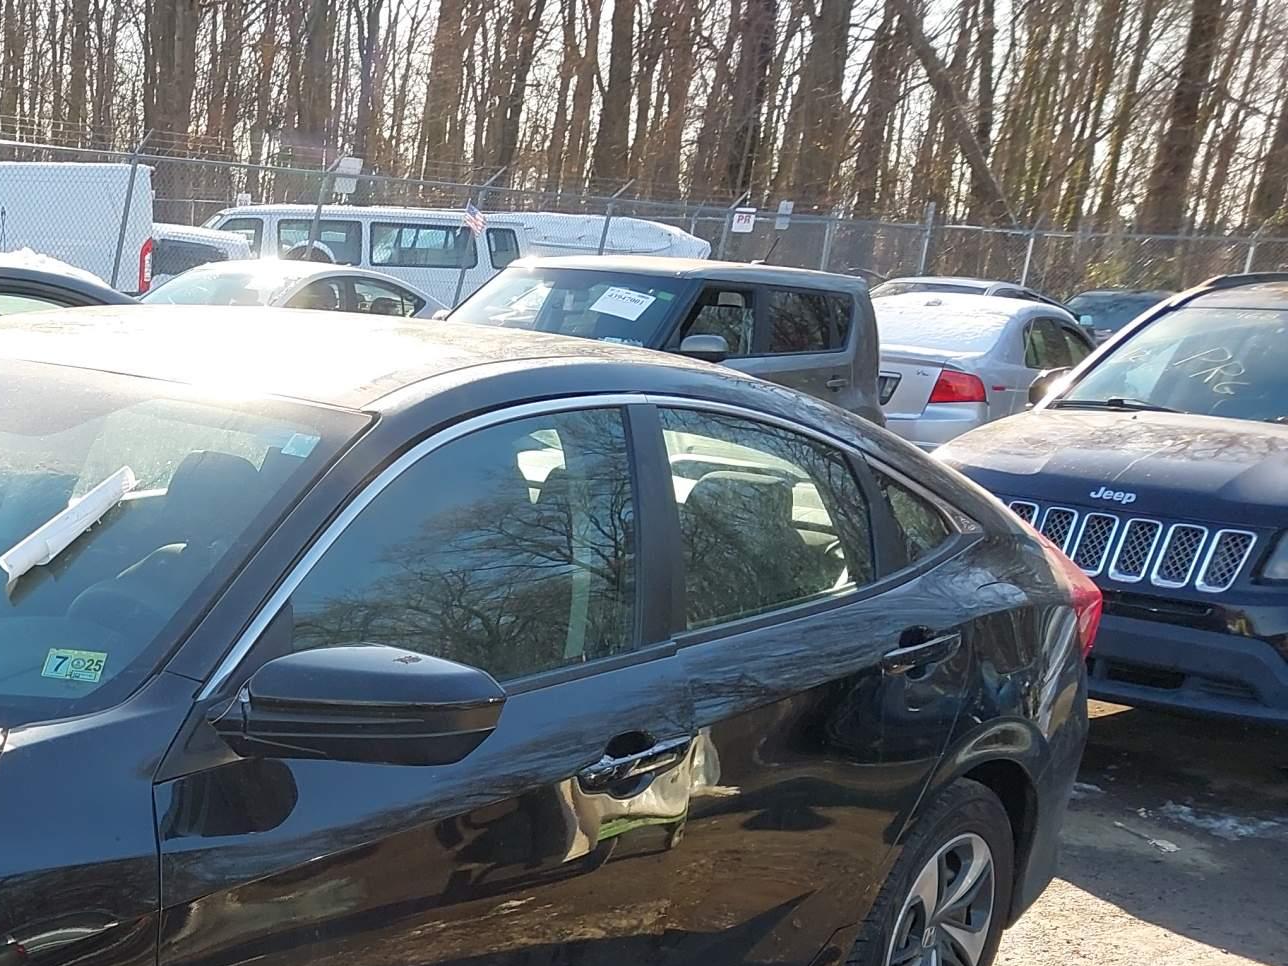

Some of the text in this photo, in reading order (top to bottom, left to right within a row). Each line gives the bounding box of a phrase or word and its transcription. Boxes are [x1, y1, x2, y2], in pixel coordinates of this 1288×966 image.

[1089, 486, 1137, 504] Jeep
[53, 655, 103, 672] 7 25
